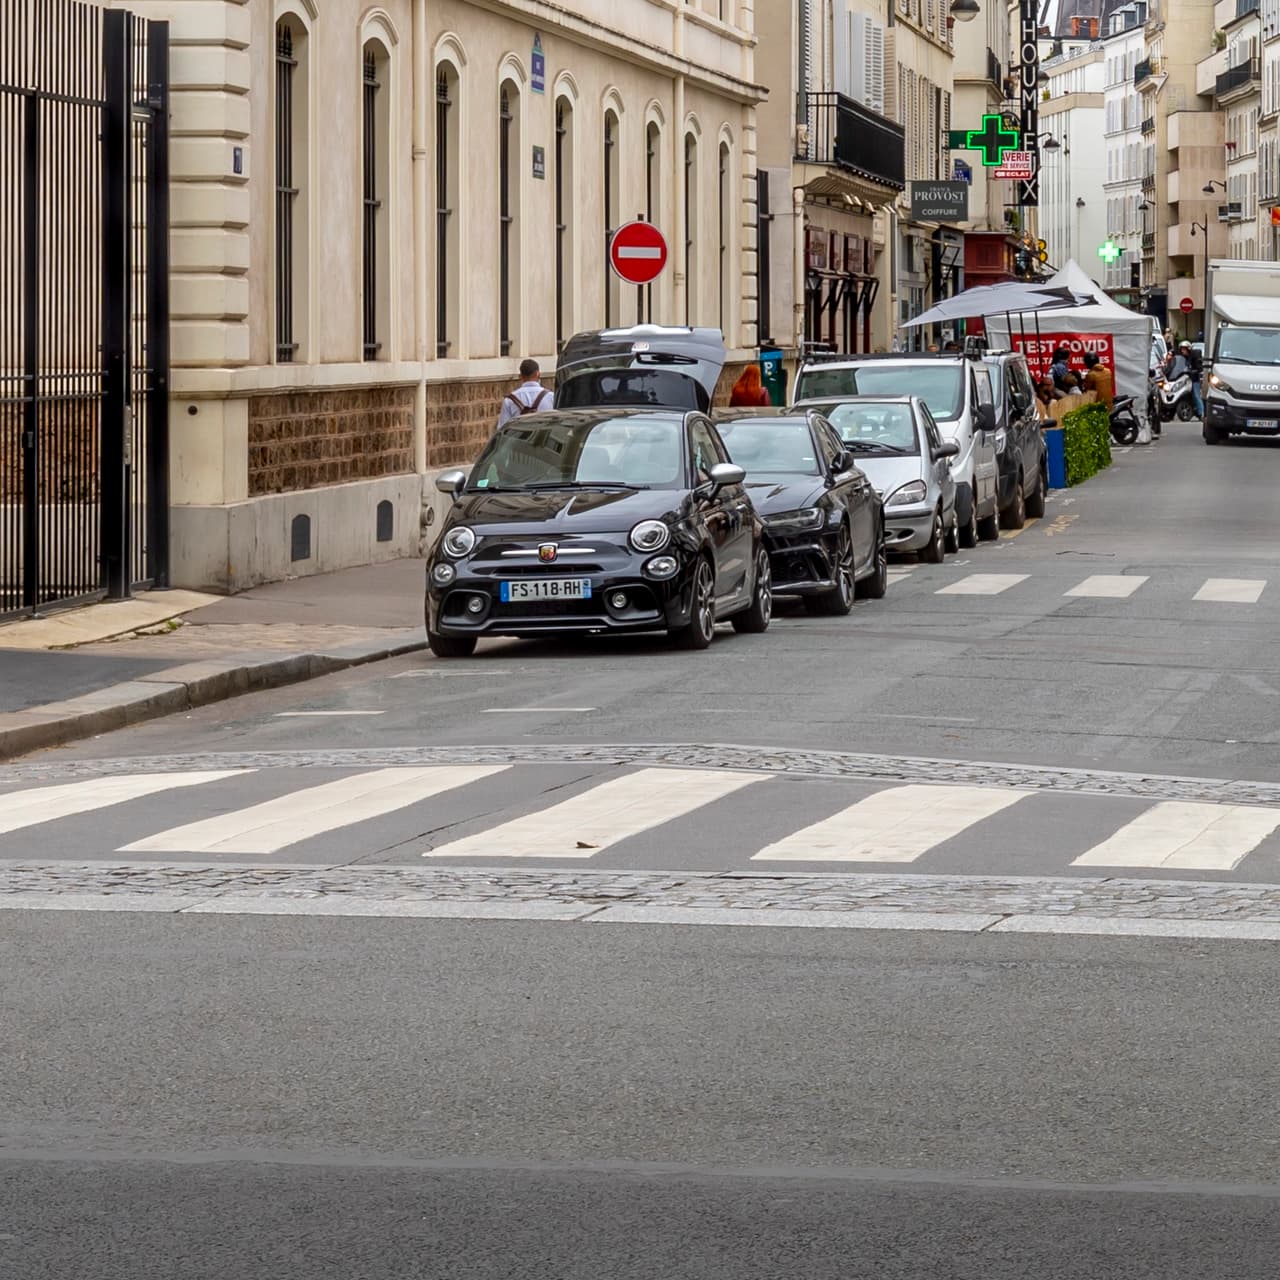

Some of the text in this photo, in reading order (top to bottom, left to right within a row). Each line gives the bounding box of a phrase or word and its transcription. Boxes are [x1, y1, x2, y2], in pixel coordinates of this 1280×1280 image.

[914, 191, 966, 201] PROVOST
[921, 208, 958, 216] COIFFURE
[1016, 339, 1109, 354] TEST COVID
[1249, 383, 1279, 391] IVECO
[511, 580, 581, 597] FS-118-AH
